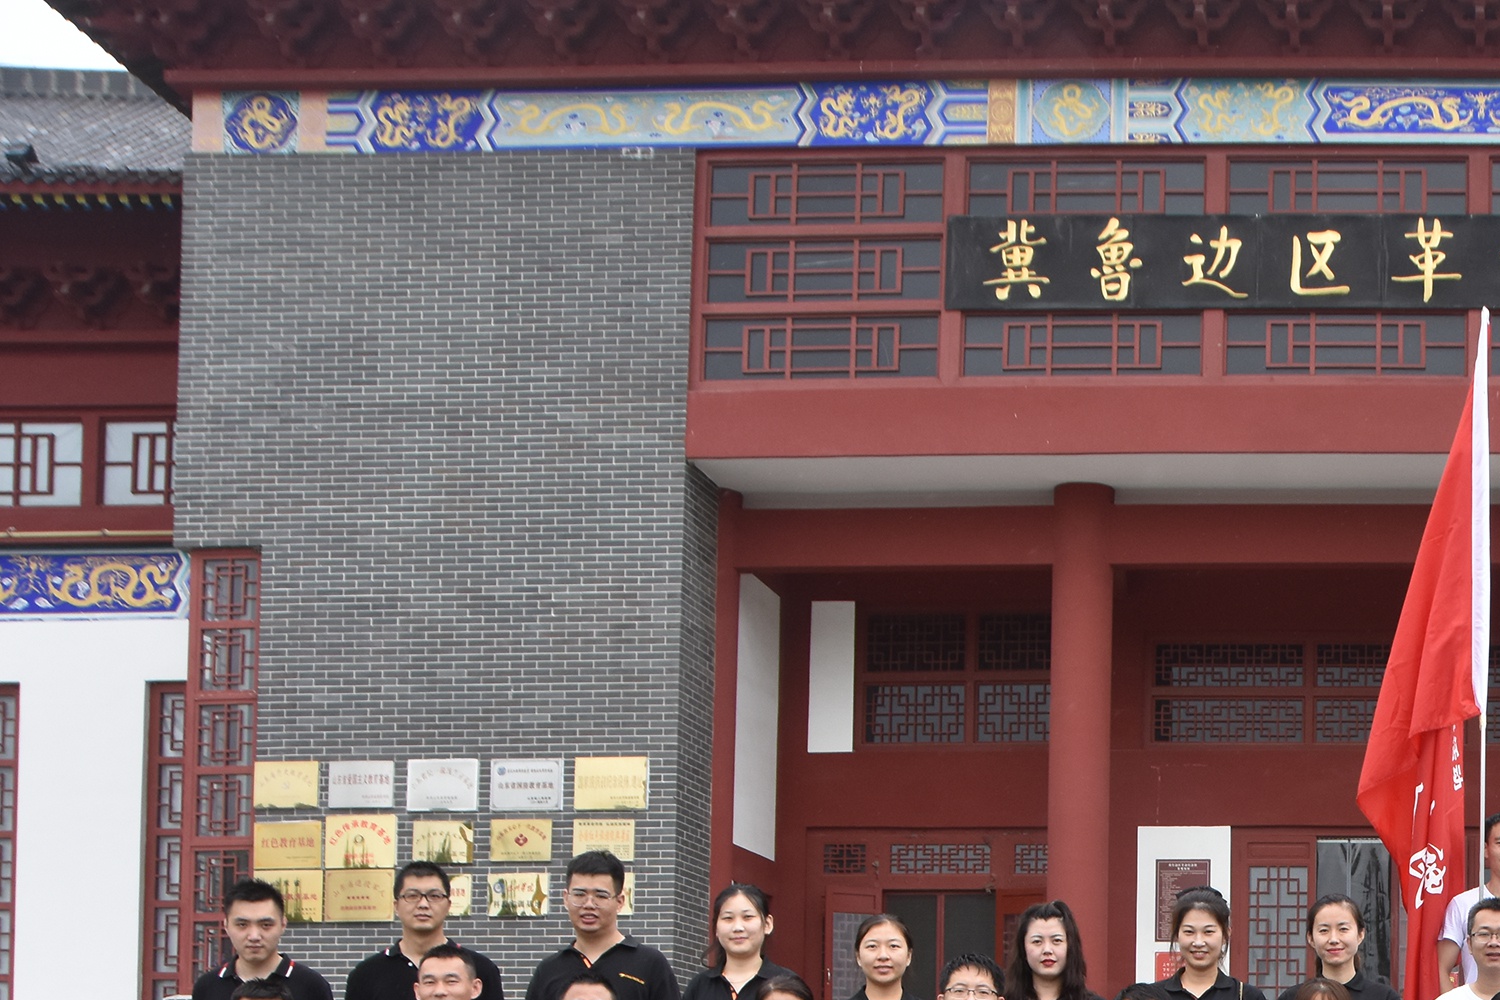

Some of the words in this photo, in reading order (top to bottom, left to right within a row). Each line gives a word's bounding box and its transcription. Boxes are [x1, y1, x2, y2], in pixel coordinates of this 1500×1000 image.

[329, 820, 391, 846] 红色传承教育基地
[261, 837, 315, 848] 红色教育基地
